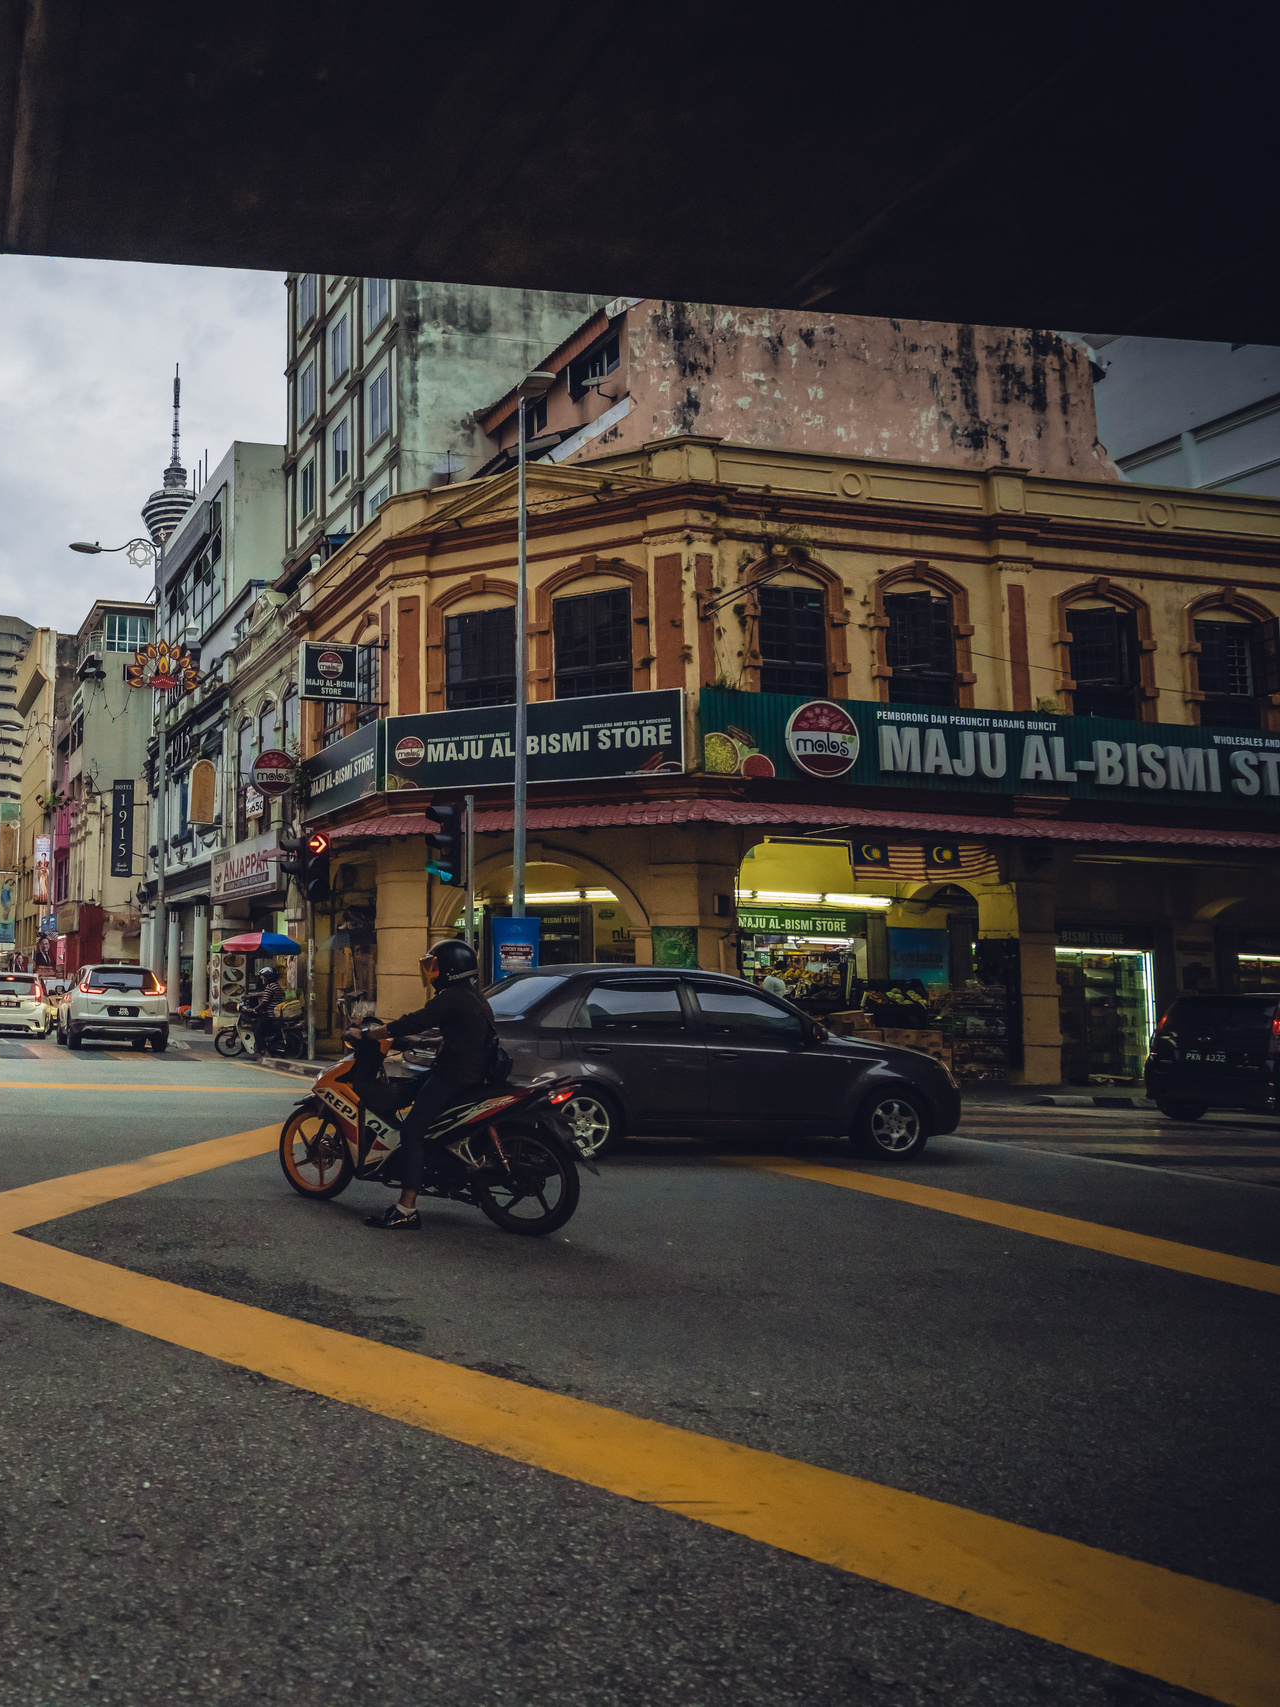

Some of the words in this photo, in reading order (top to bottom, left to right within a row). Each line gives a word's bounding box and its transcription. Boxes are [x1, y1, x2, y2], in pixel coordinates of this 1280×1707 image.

[306, 678, 324, 686] MAJU
[325, 680, 355, 689] AL-BISMI
[320, 686, 342, 695] STORE
[876, 710, 929, 724] PEMBORONG
[930, 713, 948, 725] DAN
[949, 715, 991, 728] PERUNCIT
[992, 718, 1025, 730] BARANG
[1027, 720, 1058, 732] RUNCIT
[427, 739, 484, 763] MAJU
[490, 730, 590, 759] ALBISMI
[597, 724, 673, 750] STORE
[1212, 735, 1264, 748] WHOLESALES
[877, 724, 1007, 779] MAJU
[1020, 734, 1222, 793] AL-BISMI
[325, 763, 353, 790] AL-BISMI
[353, 752, 375, 777] STORE
[118, 794, 128, 858] 1915
[223, 849, 269, 881] ANJAPPAR
[738, 917, 767, 929] MAJU
[769, 918, 813, 931] AL-BISMI
[815, 920, 847, 933] STORE
[1093, 931, 1125, 944] STORE
[1185, 1053, 1201, 1061] PKN
[1205, 1053, 1227, 1063] 4332
